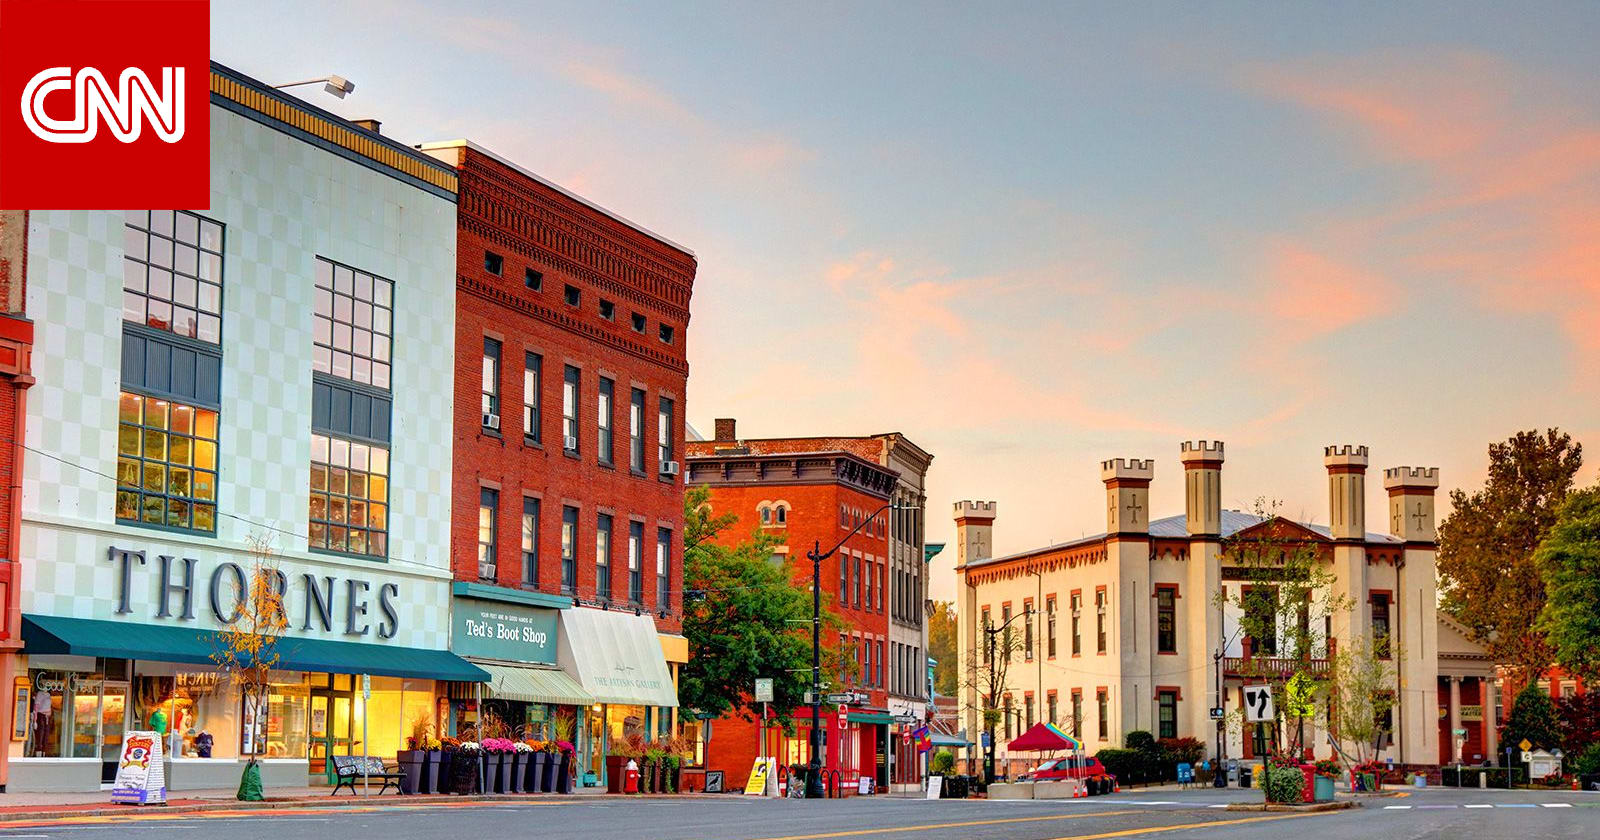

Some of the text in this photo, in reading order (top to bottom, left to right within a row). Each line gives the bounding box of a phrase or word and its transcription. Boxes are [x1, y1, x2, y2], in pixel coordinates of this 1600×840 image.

[108, 545, 399, 639] THORNES
[466, 620, 547, 648] Ted's Boot Shop
